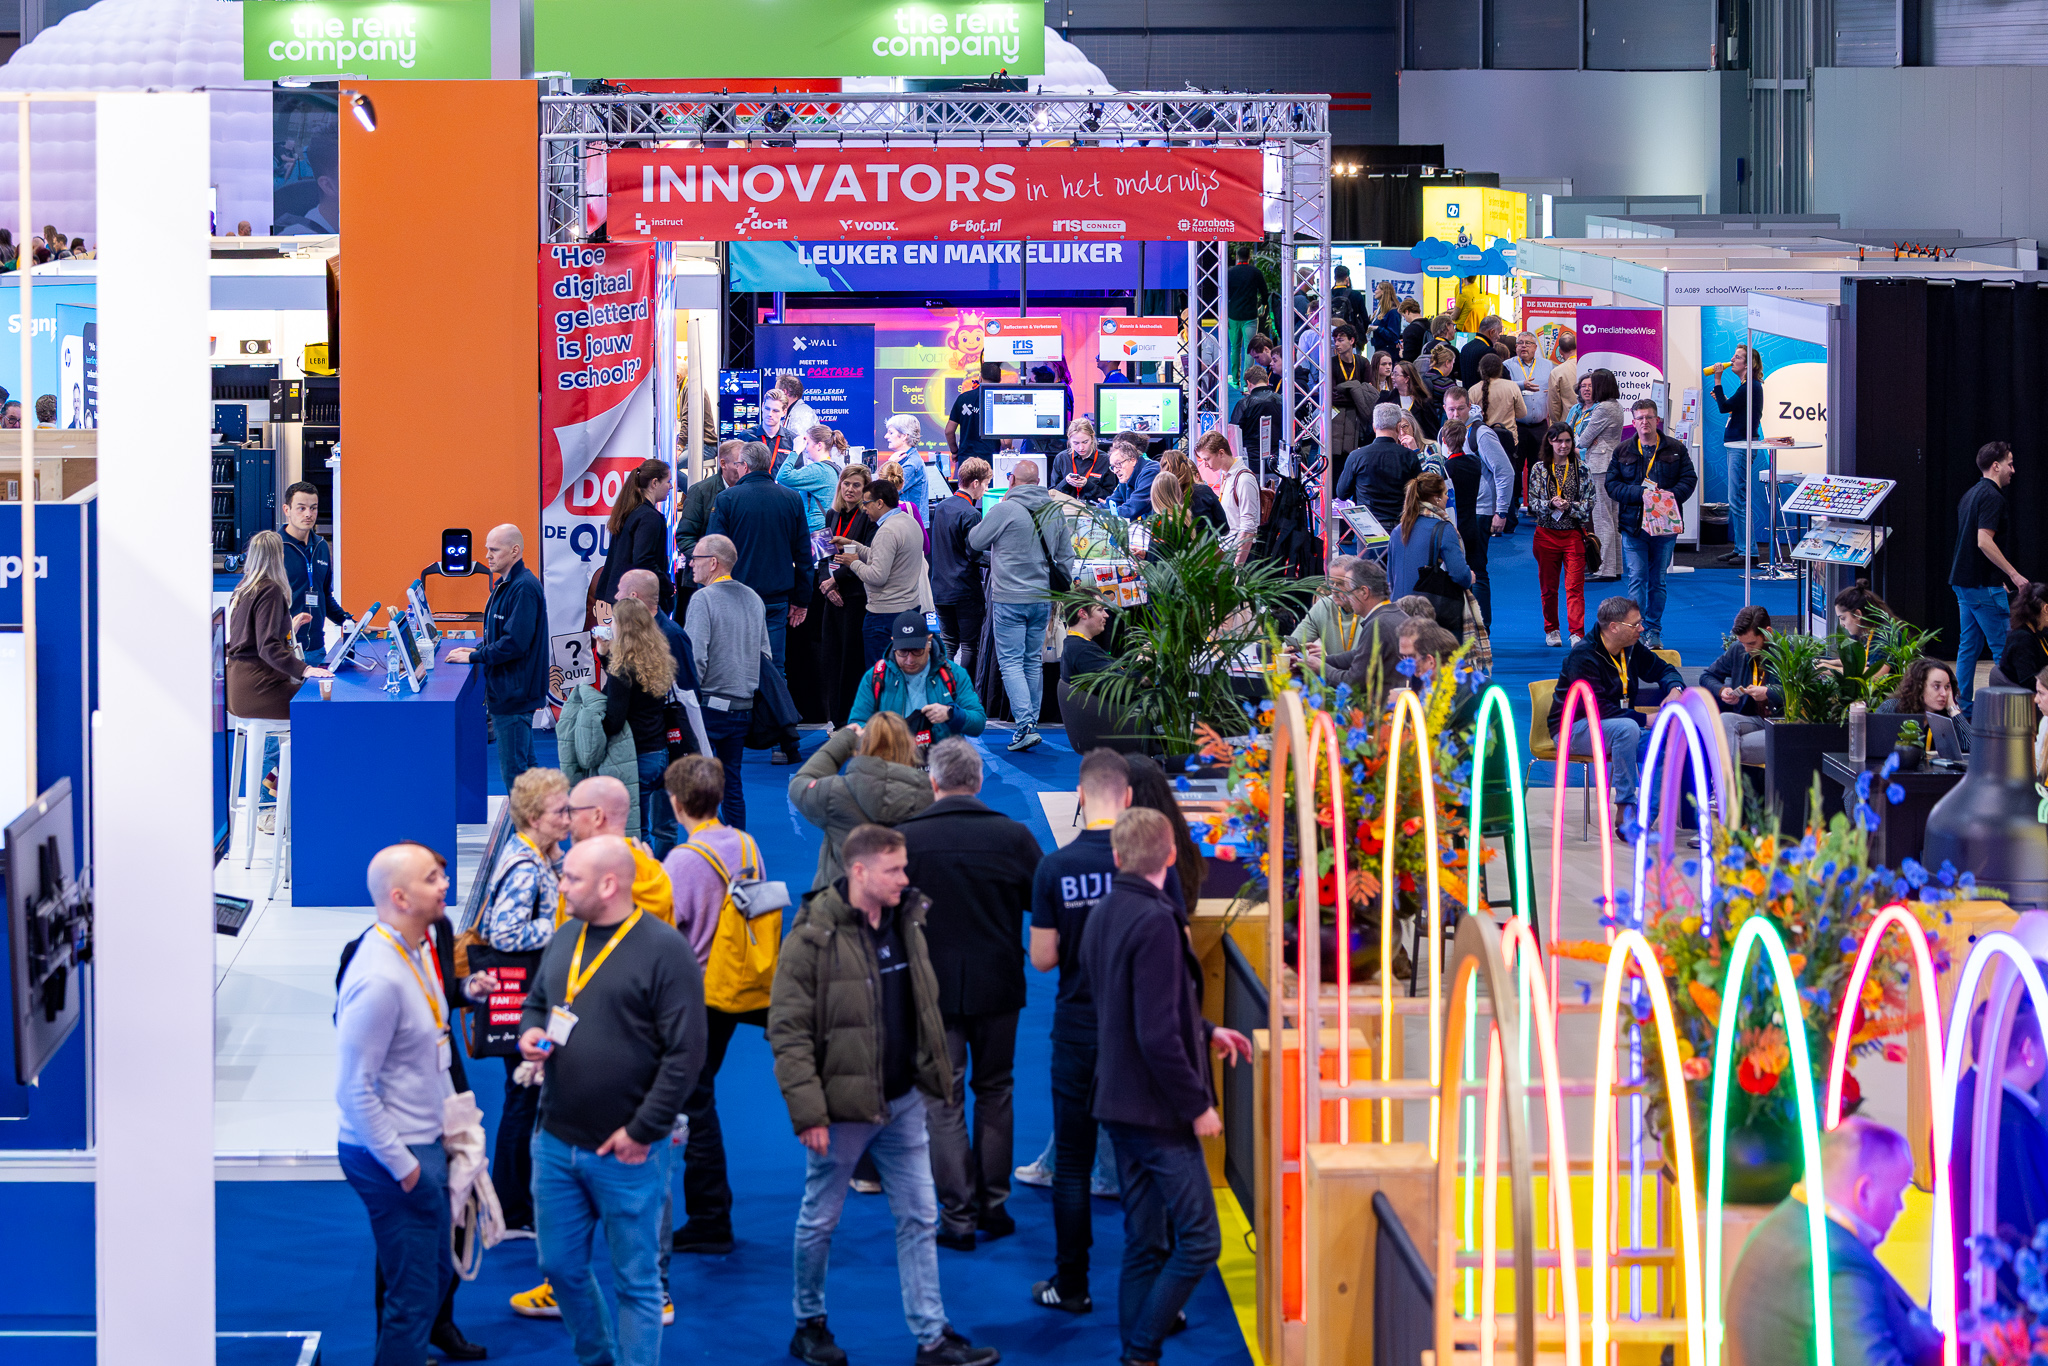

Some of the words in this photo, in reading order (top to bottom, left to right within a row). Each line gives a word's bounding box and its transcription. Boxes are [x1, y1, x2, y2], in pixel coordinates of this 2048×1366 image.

[290, 11, 345, 38] the
[352, 11, 416, 38] rent
[894, 7, 948, 34] the
[956, 7, 1019, 34] rent
[268, 40, 416, 69] company
[872, 35, 1020, 65] company
[642, 164, 1016, 203] INNOVATORS
[1026, 178, 1048, 201] in
[1061, 172, 1103, 199] het
[1114, 167, 1220, 207] onderwijs
[651, 217, 684, 226] instruct
[751, 218, 788, 230] do-it
[854, 221, 899, 231] VODIX.
[949, 219, 1002, 233] B-Bot.nl
[1192, 218, 1235, 228] Zorabots
[1192, 226, 1235, 234] Nederland
[798, 245, 898, 265] LEUKER
[903, 244, 938, 265] EN
[944, 243, 1123, 264] MAKKELIJKER
[554, 270, 632, 300] digitaal
[556, 297, 648, 333] geletterd
[1597, 325, 1656, 335] mediatheekWise
[557, 337, 580, 359] is
[584, 335, 633, 362] jouw
[763, 367, 806, 377] X-WALL
[807, 367, 865, 377] PORTABLE
[1629, 370, 1650, 378] voor
[902, 385, 924, 394] Speler
[910, 394, 925, 405] 85
[1779, 401, 1827, 421] Zoek
[572, 470, 629, 508] DO
[544, 524, 567, 540] DE
[565, 640, 583, 667] ?
[564, 667, 592, 681] QUIZ
[491, 1012, 523, 1022] ONDER
